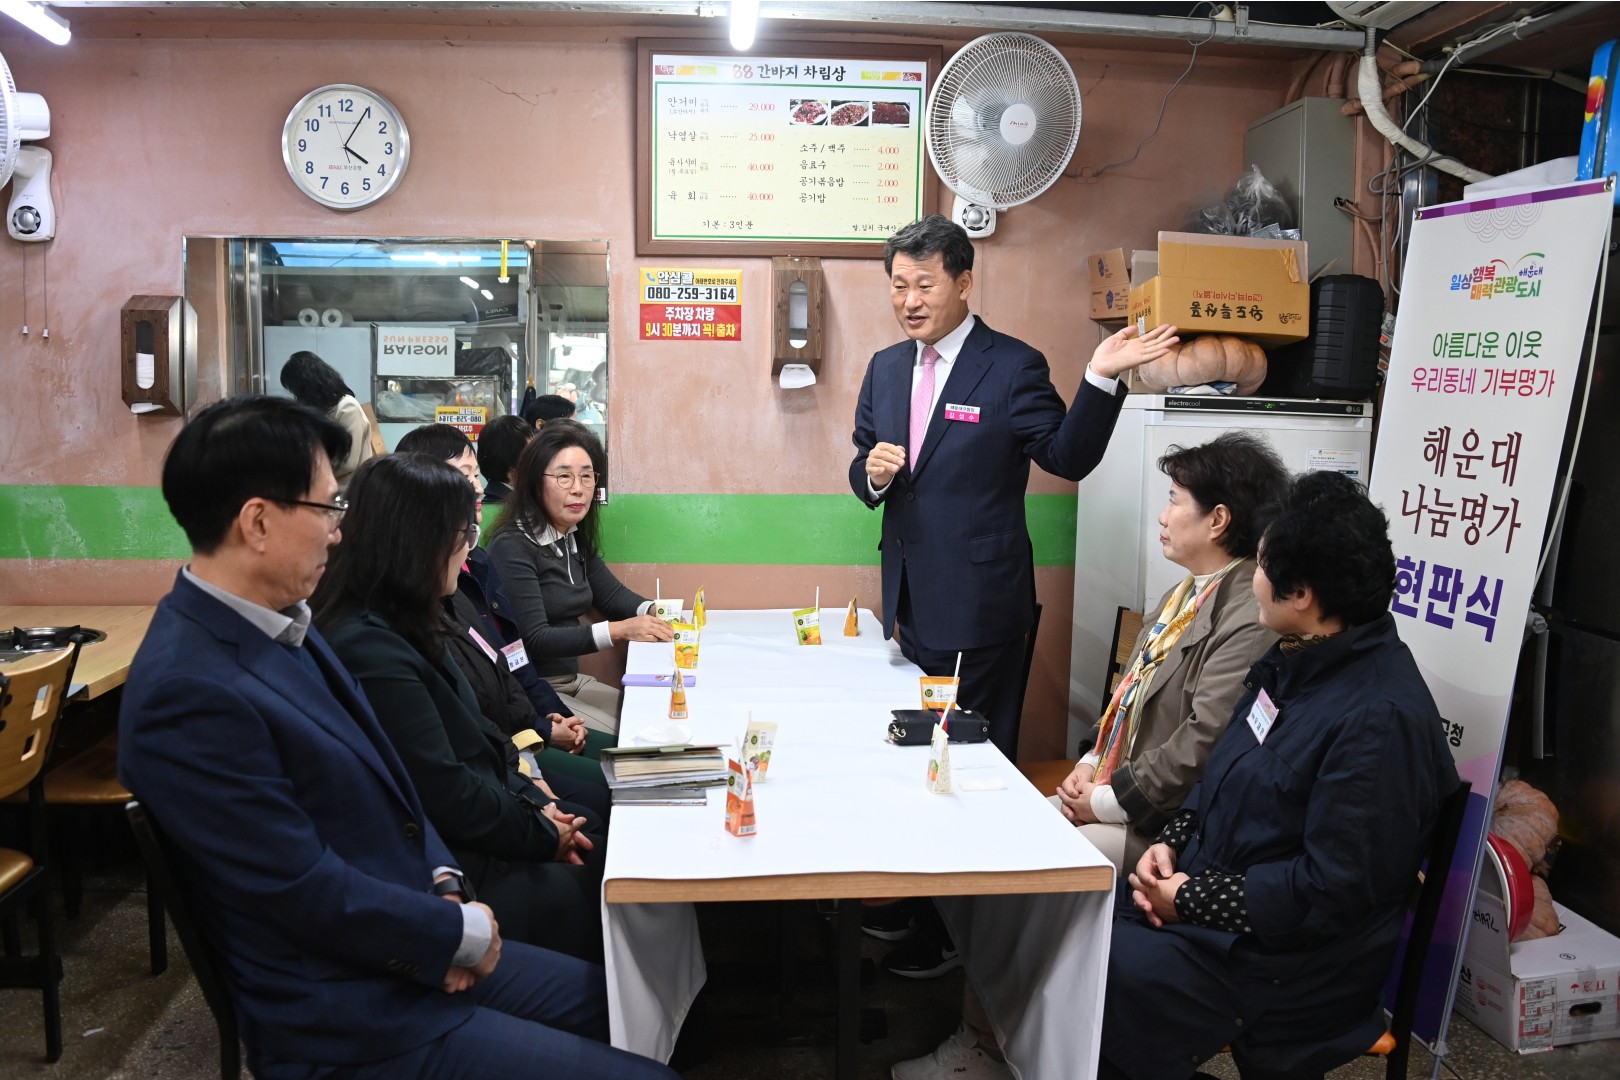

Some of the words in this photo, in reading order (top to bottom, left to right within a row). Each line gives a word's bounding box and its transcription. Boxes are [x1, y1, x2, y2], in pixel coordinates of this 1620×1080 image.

[733, 64, 753, 79] 88
[757, 64, 798, 80] 간바지
[803, 64, 847, 81] 차림상
[317, 104, 332, 118] 11
[338, 98, 354, 113] 12
[667, 96, 697, 108] 안거미
[748, 102, 776, 112] 29.000
[366, 106, 372, 119] 1
[304, 118, 320, 132] 10
[378, 121, 388, 134] 2
[667, 130, 697, 142] 낙엽살
[748, 133, 776, 142] 25.000
[297, 138, 307, 152] 9
[384, 142, 393, 155] 3
[799, 143, 818, 154] 소주
[828, 143, 846, 154] 맥주
[877, 146, 900, 155] 4.000
[305, 161, 314, 174] 8
[377, 163, 386, 177] 4
[668, 157, 697, 168] 육사시미
[747, 162, 775, 172] 40.000
[799, 159, 827, 170] 음료수
[877, 162, 899, 171] 2.000
[319, 176, 329, 190] 7
[340, 181, 350, 195] 6
[362, 178, 371, 191] 5
[799, 176, 846, 188] 공기볶음밥
[877, 178, 899, 188] 2.000
[747, 192, 775, 202] 40.000
[799, 192, 827, 204] 공기밥
[877, 195, 899, 204] 1.000
[702, 219, 720, 230] 기본
[729, 220, 754, 230] 3인분
[877, 224, 897, 233] 국내산
[657, 271, 695, 286] 안심콜
[1518, 265, 1544, 278] 해운대
[647, 286, 735, 301] 080-259-3164
[665, 306, 694, 322] 주차장
[695, 306, 715, 322] 차량
[1189, 301, 1264, 322] 완도특산품
[645, 322, 660, 337] 9시
[662, 322, 701, 337] 30분까지
[716, 323, 736, 338] 출차
[1432, 331, 1500, 359] 아름다운
[1505, 330, 1543, 359] 이웃
[1411, 367, 1477, 395] 우리동네
[1480, 368, 1555, 398] 기부명가
[1423, 425, 1523, 487] 해운대
[1401, 484, 1521, 554] 나눔명가
[1390, 555, 1504, 643] 현판식
